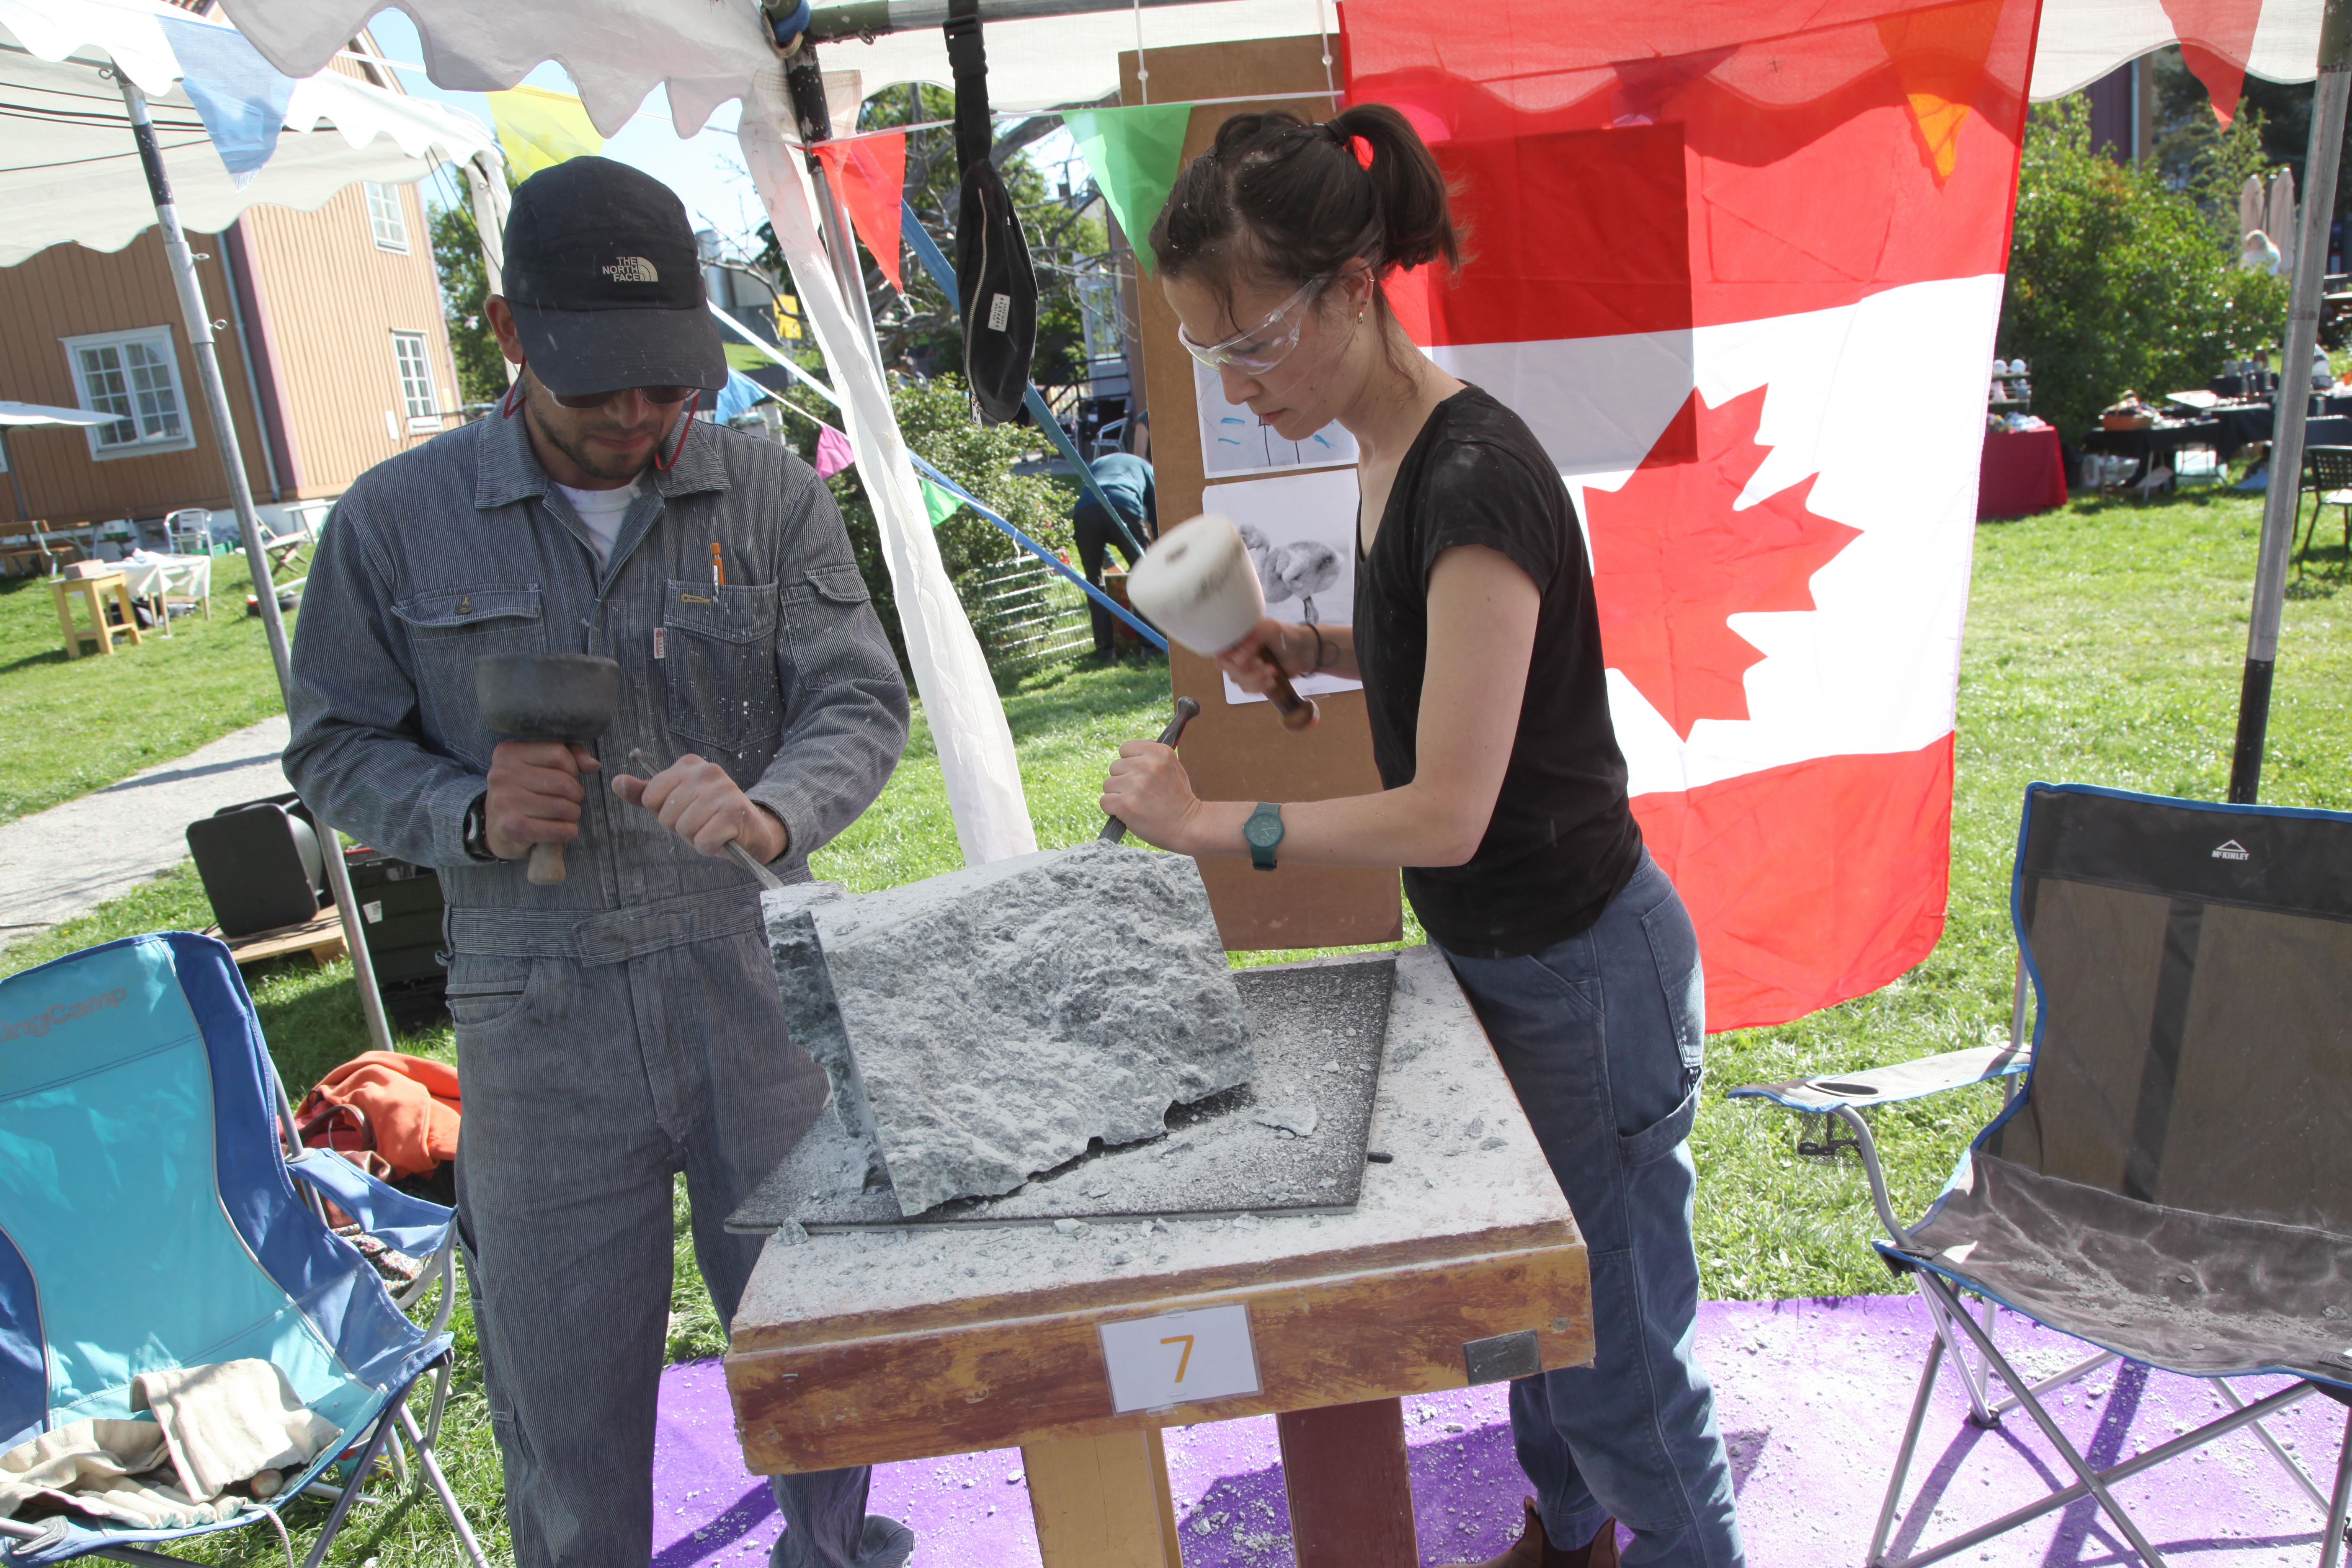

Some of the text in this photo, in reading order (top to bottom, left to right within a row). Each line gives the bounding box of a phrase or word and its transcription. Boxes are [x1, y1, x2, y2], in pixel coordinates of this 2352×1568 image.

[616, 257, 637, 265] THE
[602, 266, 638, 275] NORTH
[614, 273, 640, 282] FACE
[0, 987, 127, 1043] ingCamp
[1160, 1335, 1194, 1383] 7
